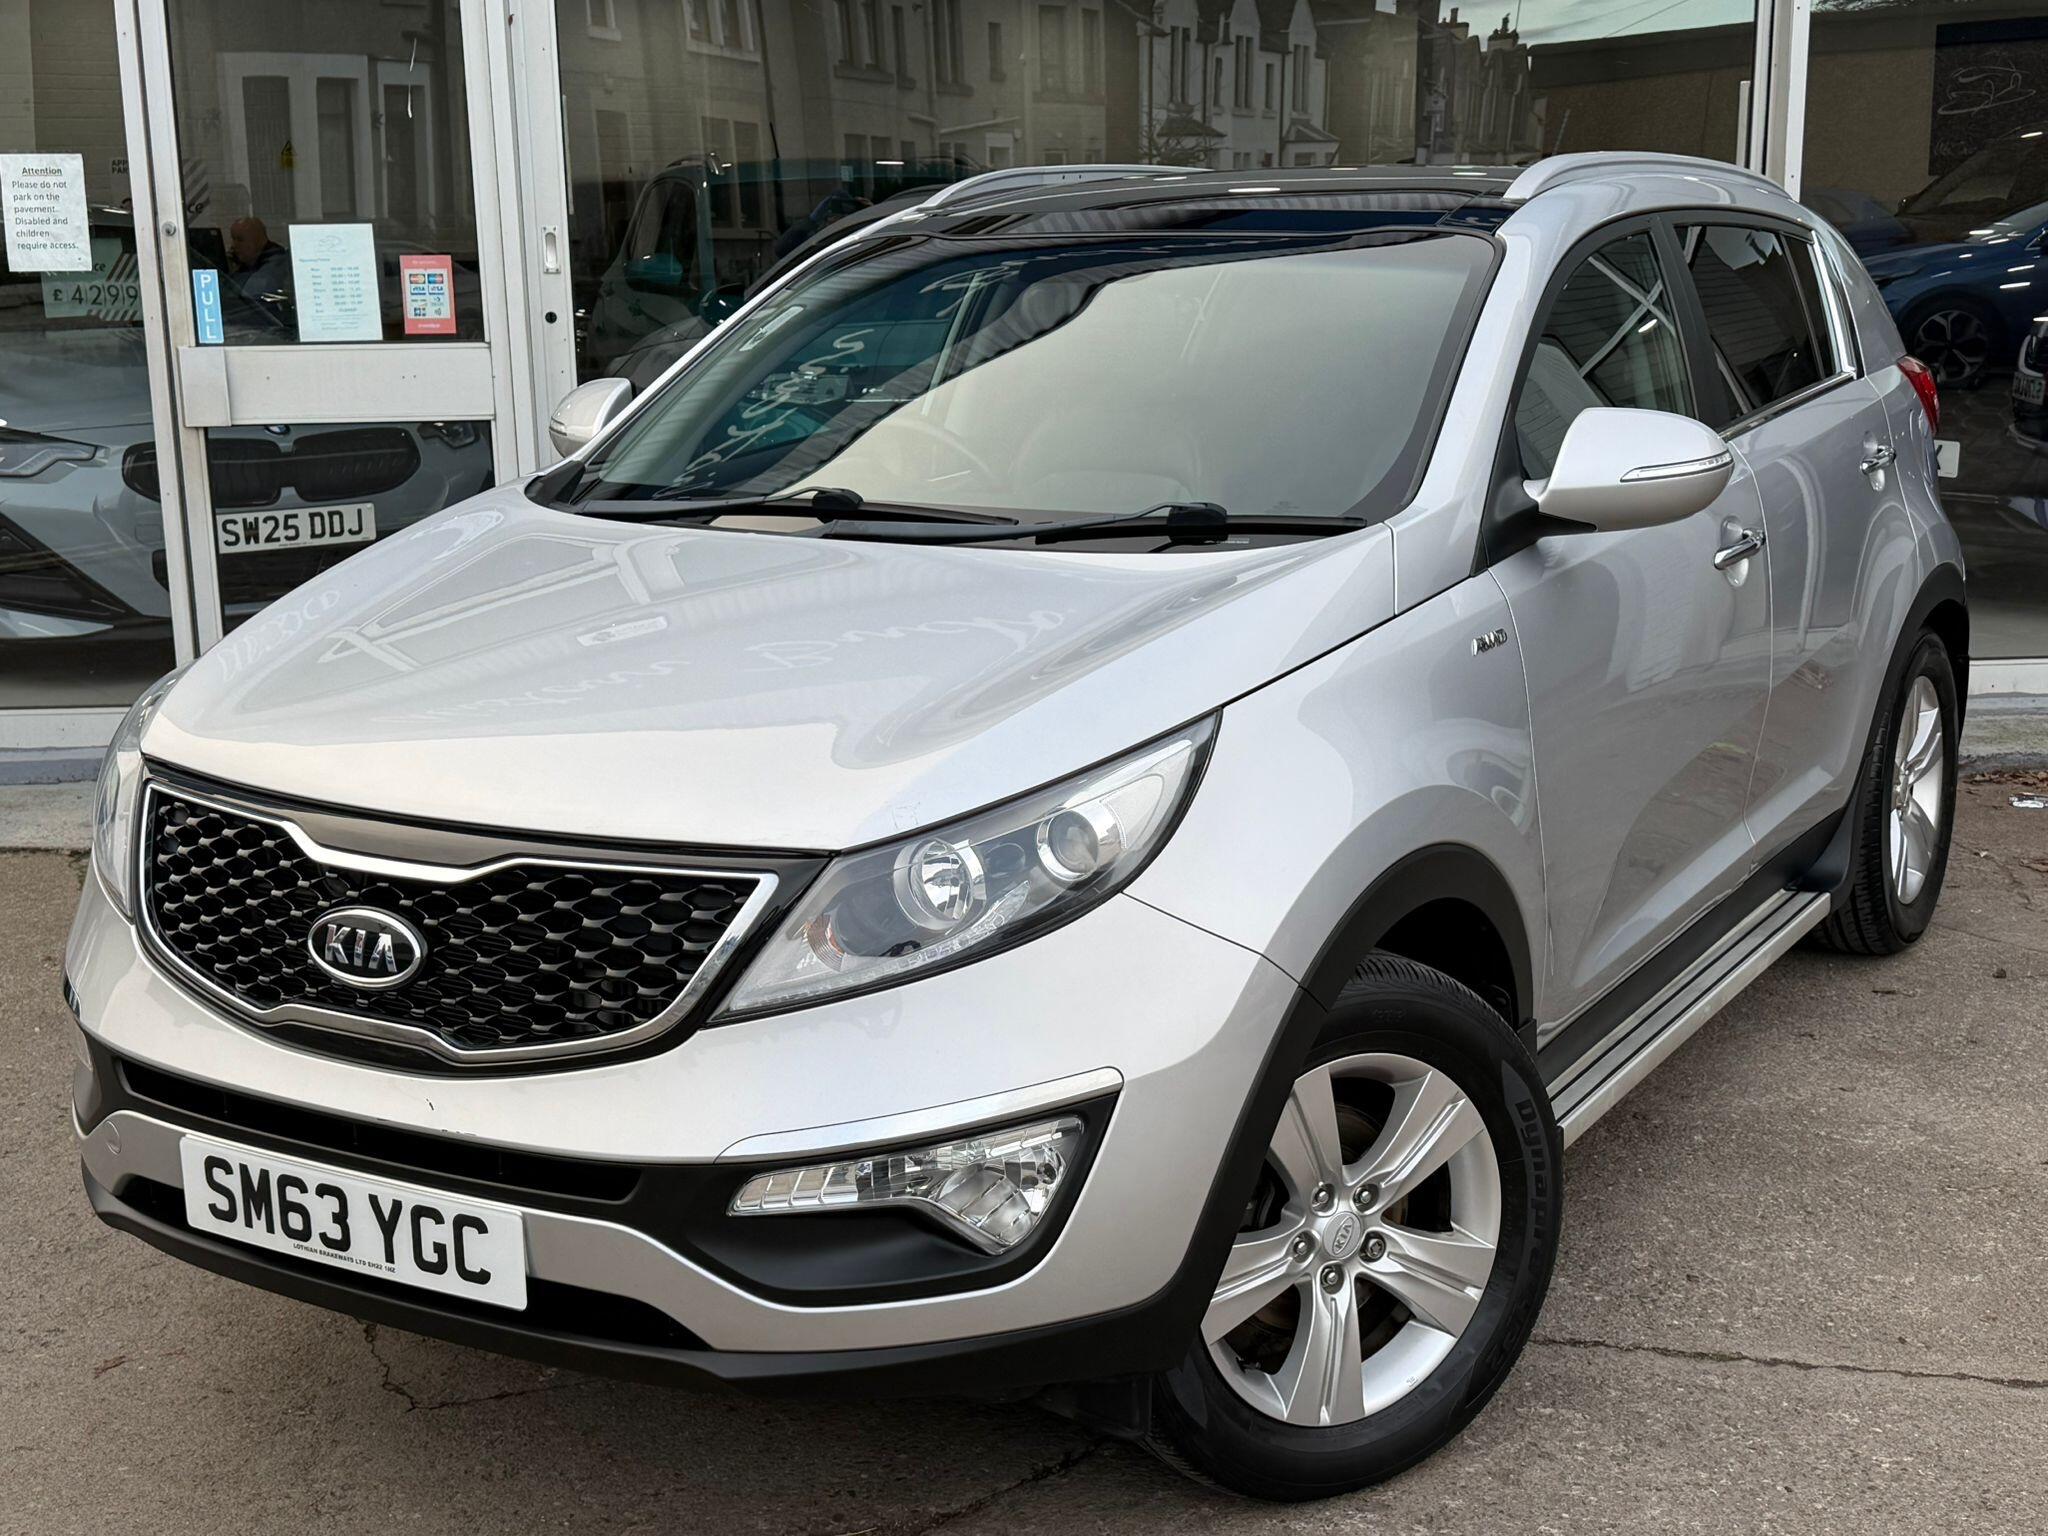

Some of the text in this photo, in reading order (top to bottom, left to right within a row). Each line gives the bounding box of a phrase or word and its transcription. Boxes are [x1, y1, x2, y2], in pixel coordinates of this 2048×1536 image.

[22, 167, 63, 176] Attention
[12, 181, 67, 189] Please do not
[13, 193, 32, 203] park
[46, 193, 60, 201] the
[15, 217, 68, 225] Disabled and
[16, 229, 50, 238] children
[17, 242, 48, 251] require
[200, 274, 216, 340] PULL
[221, 508, 363, 547] SW25 DDJ
[325, 924, 397, 973] KIA
[204, 1155, 491, 1285] SM63 YGC
[293, 1243, 318, 1254] LOTHIAN
[319, 1249, 354, 1263] BRAKEWAYS
